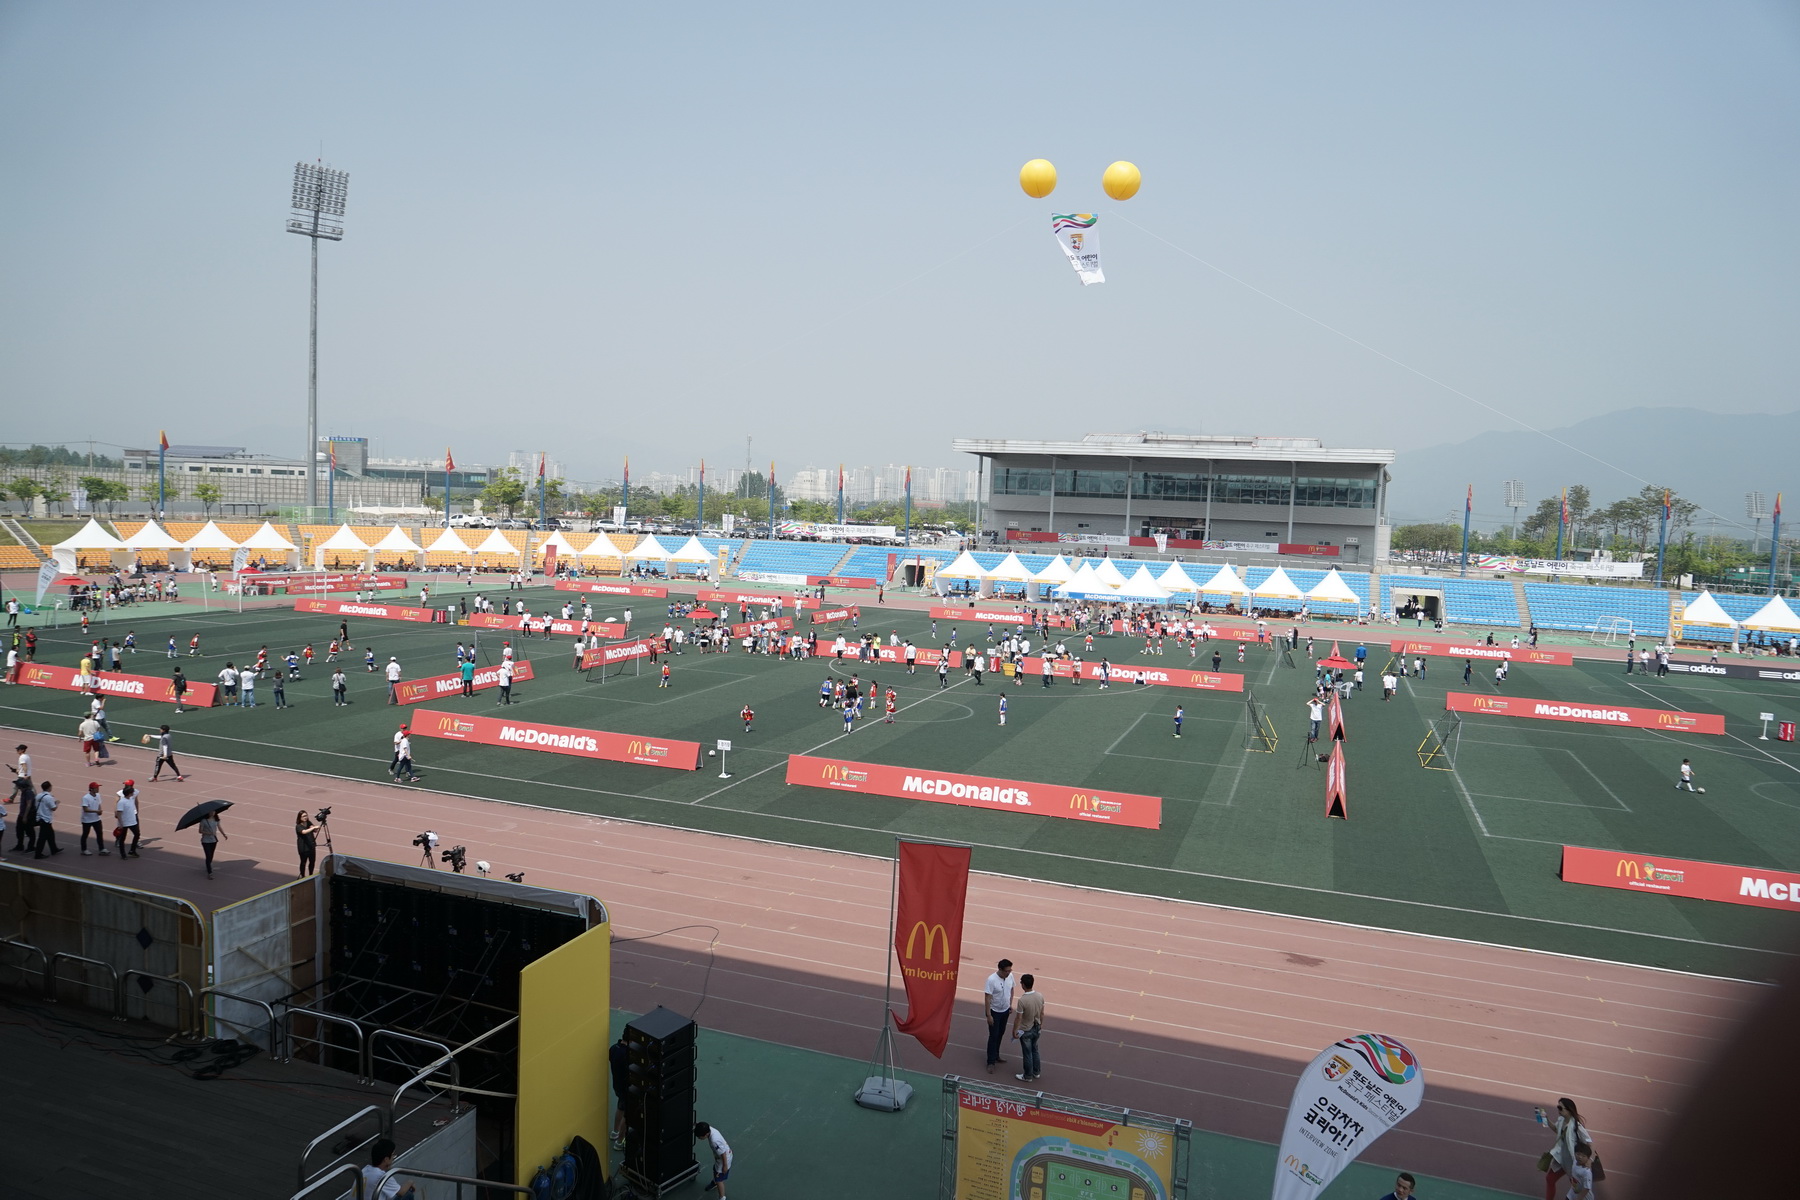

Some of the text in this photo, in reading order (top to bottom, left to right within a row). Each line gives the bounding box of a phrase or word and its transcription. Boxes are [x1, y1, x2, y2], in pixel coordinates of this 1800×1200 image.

[829, 526, 845, 534] 어린이
[1516, 560, 1545, 569] 맥도날드
[1547, 562, 1568, 570] 어린이
[1570, 562, 1583, 572] 축구
[592, 585, 631, 594] McDonald's
[1084, 593, 1121, 601] McDonald's
[339, 604, 387, 616] McDonald's
[975, 612, 1024, 622] McDonald's
[606, 639, 648, 660] McDonald's
[1449, 647, 1511, 659] McDonald's
[1690, 664, 1727, 675] adidas
[1783, 672, 1800, 680] ad
[71, 674, 143, 694] MDonald's
[1535, 703, 1630, 722] McDonald's
[500, 726, 597, 752] McDonald's
[903, 775, 1030, 806] McDonald's
[902, 965, 955, 981] 'm lovin' it
[1338, 1085, 1360, 1104] McDonald's
[1359, 1101, 1369, 1111] Kids
[1345, 1077, 1400, 1123] 축구 페스티벌
[1353, 1070, 1407, 1116] 맥도날드 어린이
[1314, 1096, 1364, 1138] 으라차차
[1304, 1108, 1354, 1151] 코리아!!
[1299, 1127, 1339, 1158] INTERVIEW ZONE
